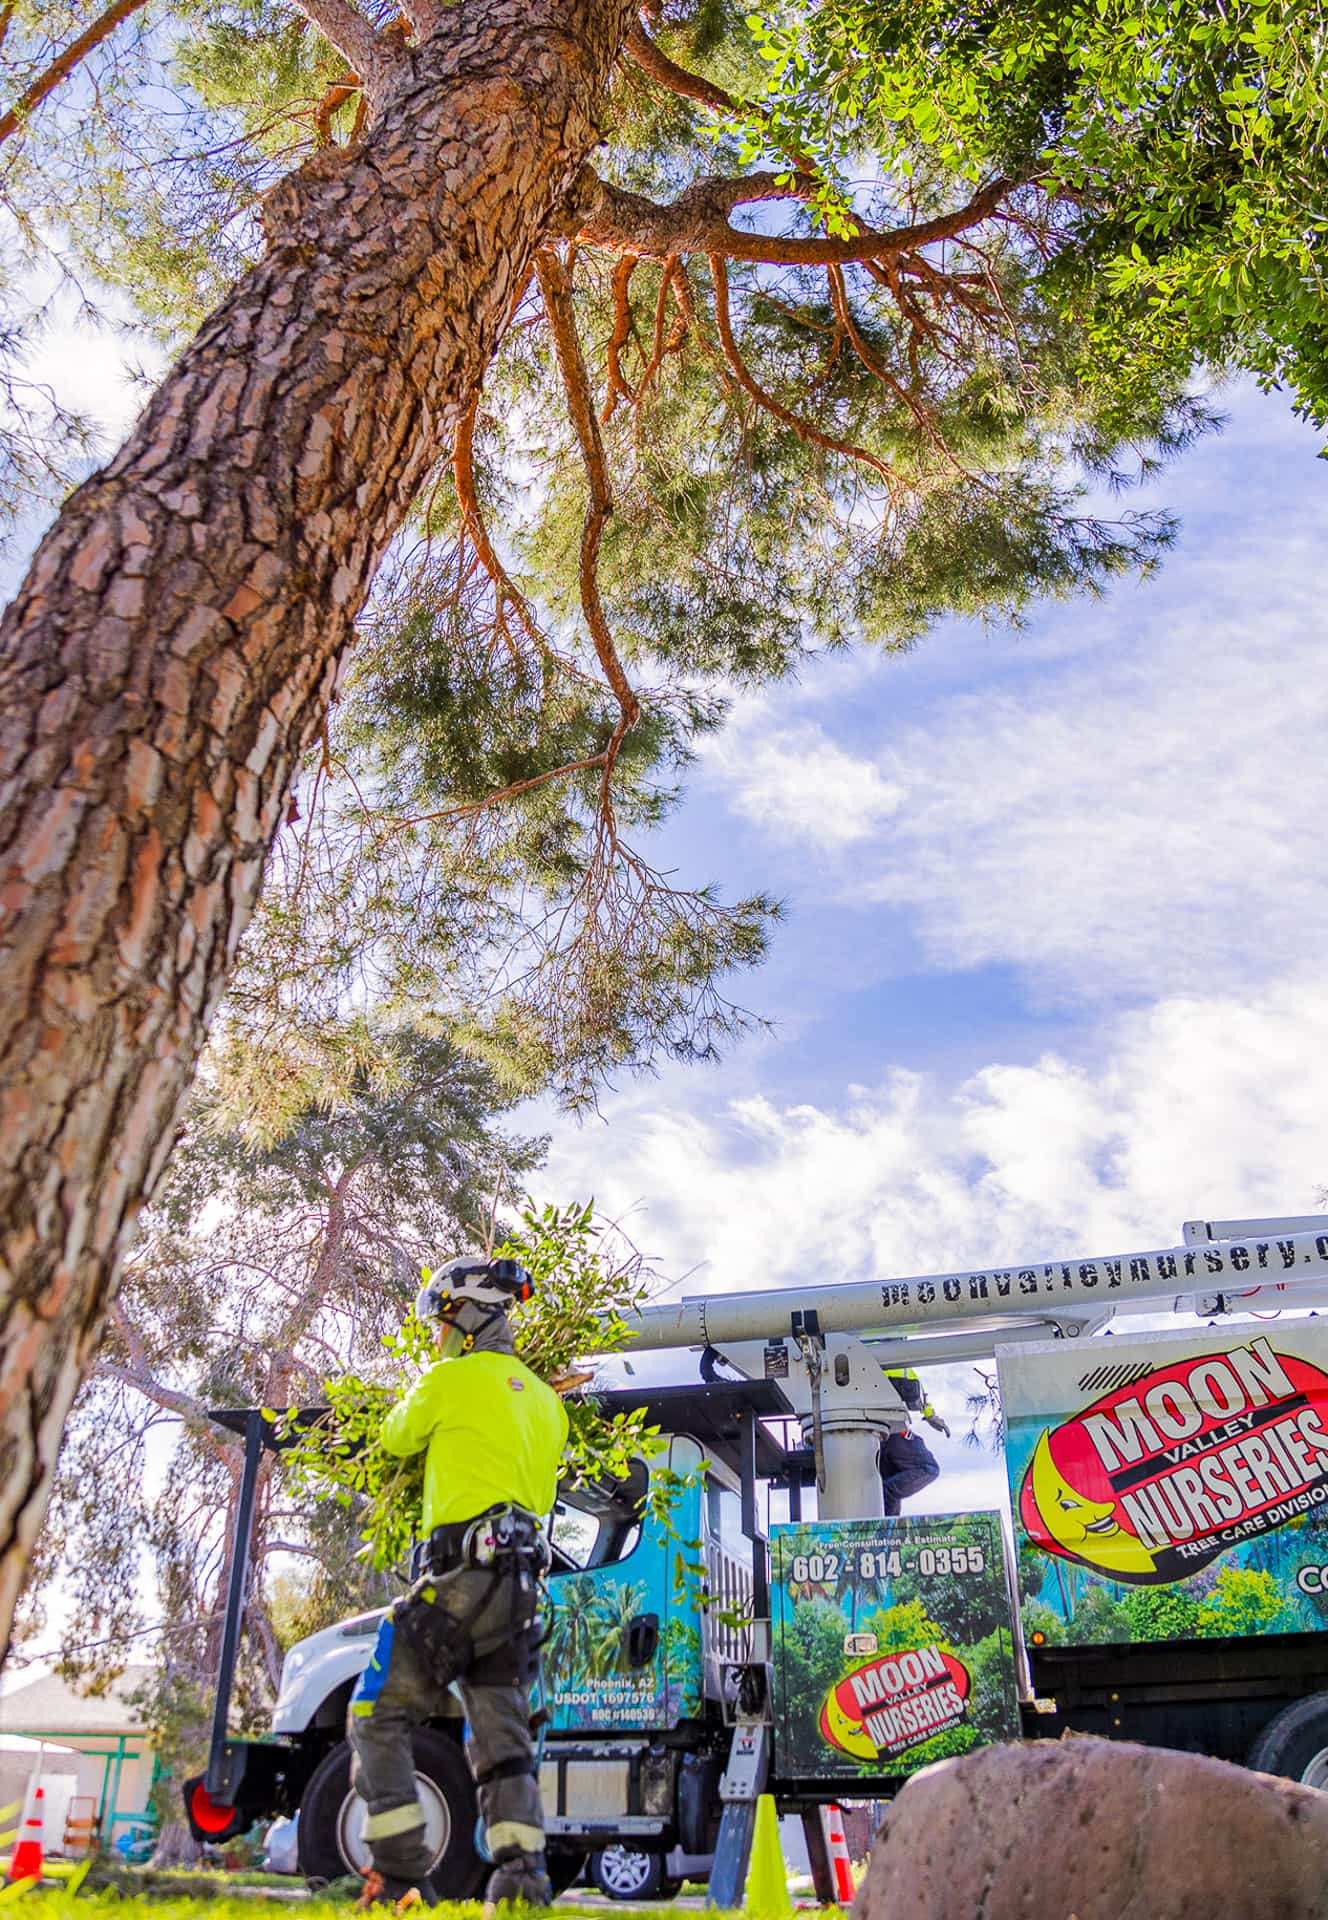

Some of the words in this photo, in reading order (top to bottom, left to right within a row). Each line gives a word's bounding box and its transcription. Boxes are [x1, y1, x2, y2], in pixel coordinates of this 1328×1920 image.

[1080, 1336, 1297, 1473] MOON
[1163, 1412, 1257, 1466] VALLEY
[1120, 1408, 1328, 1551] NURSERIES
[819, 1541, 840, 1550] Free
[842, 1537, 901, 1548] Consultation
[914, 1534, 957, 1545] Estimate
[1176, 1535, 1220, 1560] TREE
[1222, 1516, 1267, 1542] CARE
[793, 1554, 839, 1582] 602
[860, 1551, 903, 1578] 814
[919, 1546, 985, 1576] 0355
[586, 1678, 635, 1690] Phoenix,
[639, 1678, 655, 1688] AZ
[850, 1644, 947, 1707] MOON
[886, 1682, 929, 1706] VALLEY
[555, 1692, 597, 1705] USDOT
[864, 1682, 965, 1748] NURSERIES
[888, 1741, 907, 1754] TREE
[908, 1734, 928, 1746] CARE
[929, 1717, 961, 1736] DIVISION
